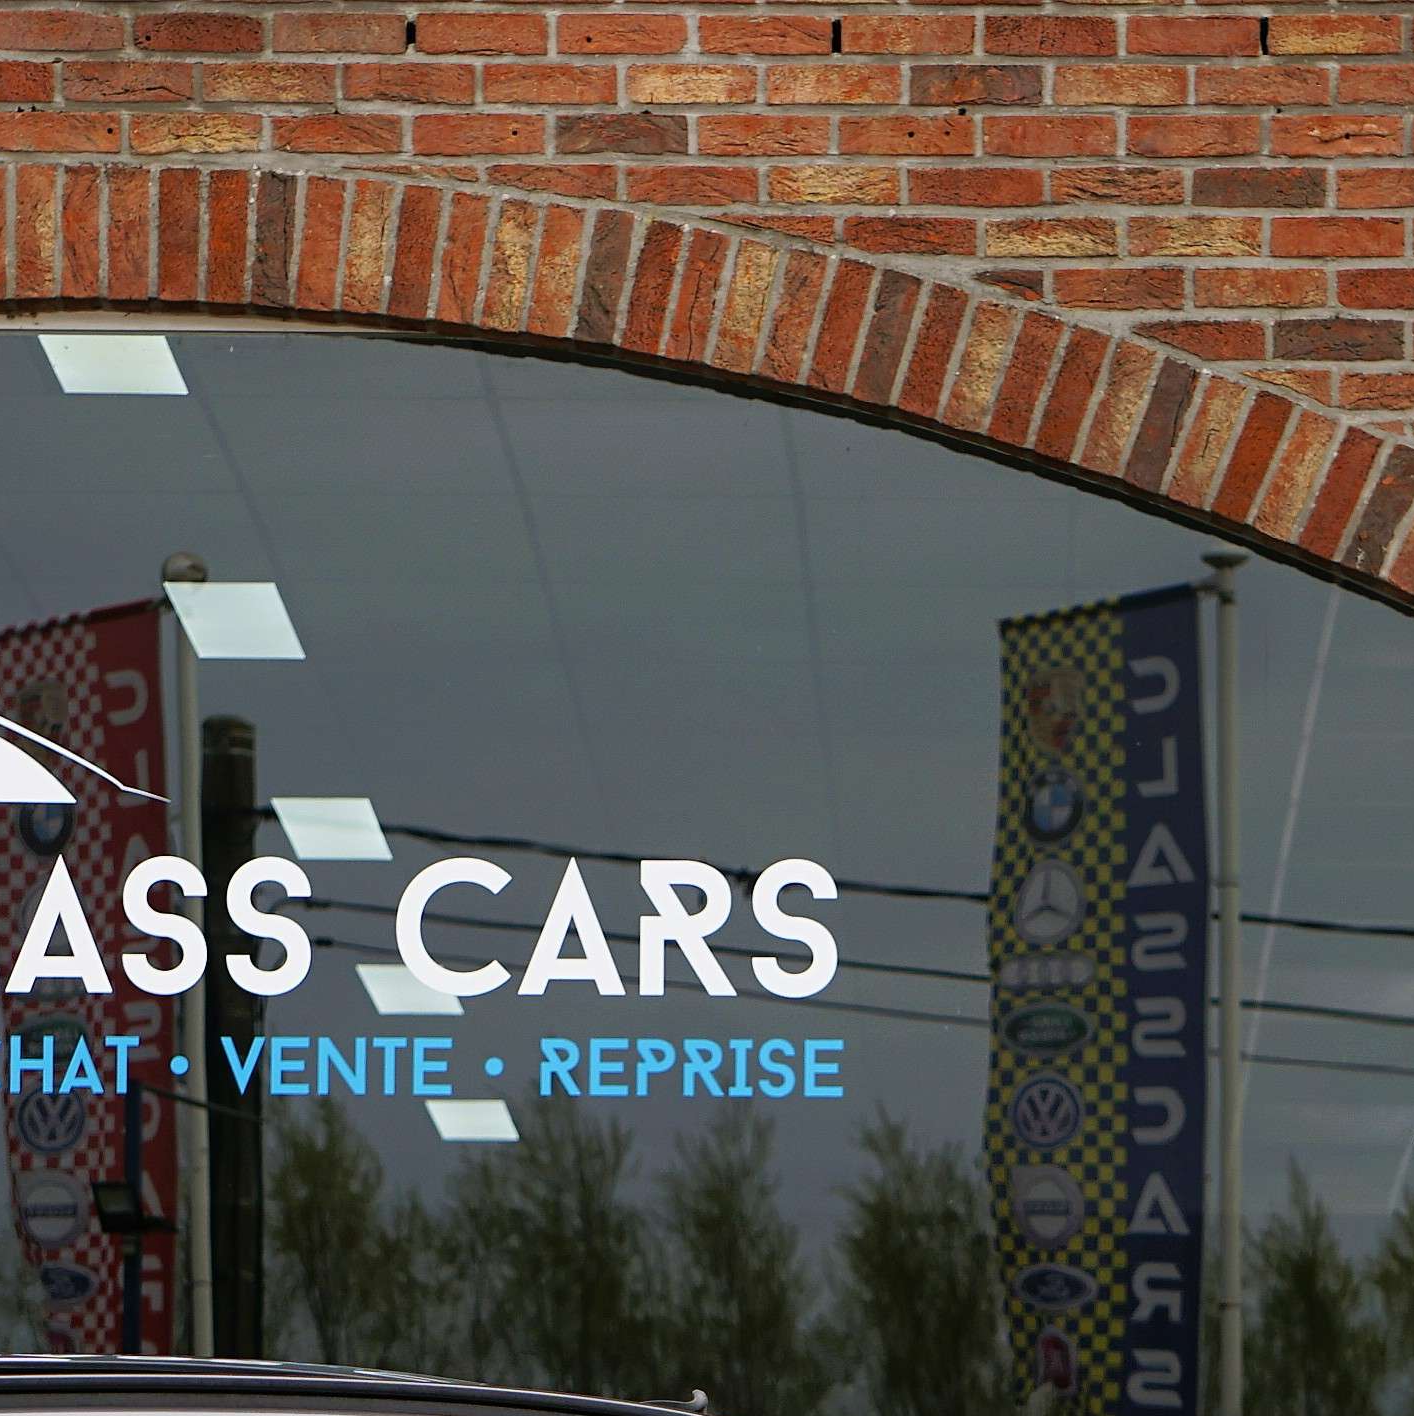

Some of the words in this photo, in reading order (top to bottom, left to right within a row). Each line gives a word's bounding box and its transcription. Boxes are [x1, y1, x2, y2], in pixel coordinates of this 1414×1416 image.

[395, 857, 837, 998] CARS
[221, 1037, 454, 1096] VENTE
[540, 1038, 844, 1098] REPRISE
